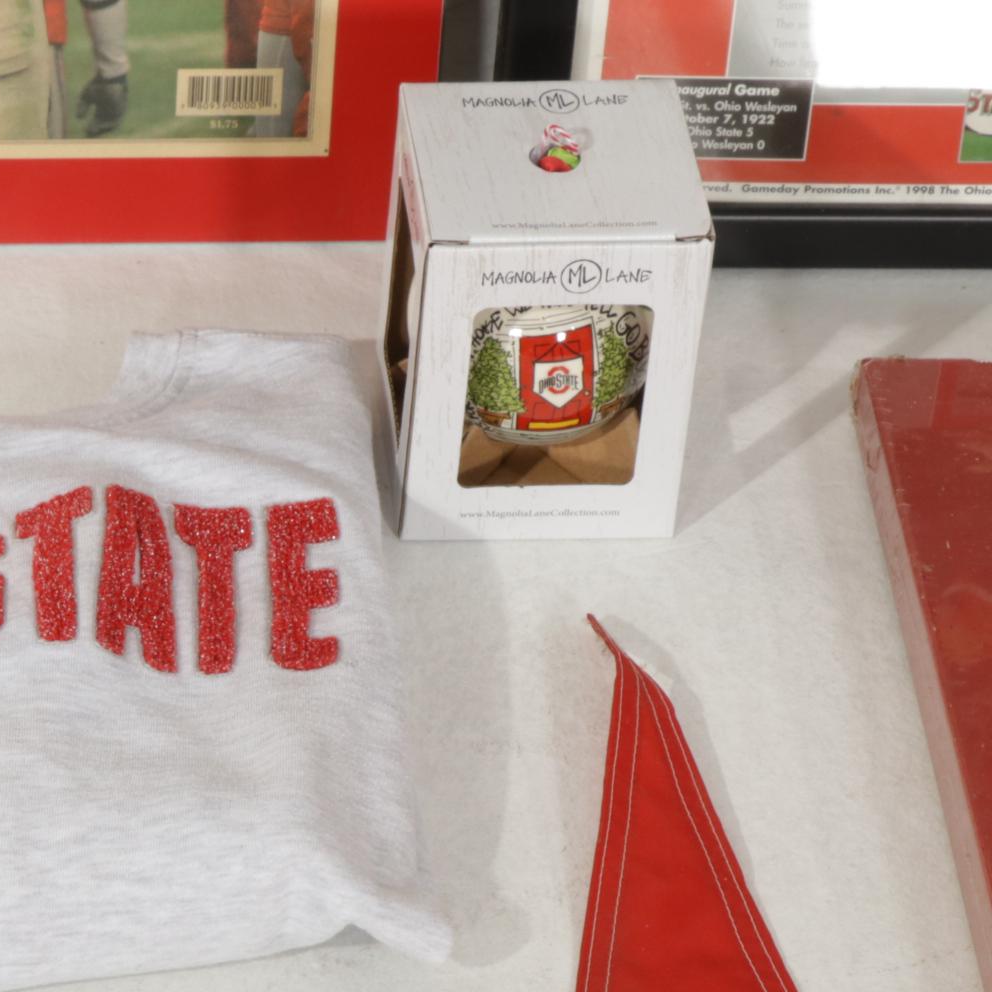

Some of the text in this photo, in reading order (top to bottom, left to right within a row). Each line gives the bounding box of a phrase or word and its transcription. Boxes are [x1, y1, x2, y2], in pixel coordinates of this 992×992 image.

[677, 82, 781, 99] naugural Game
[462, 92, 629, 109] MAGNOLIA ML LANE
[695, 102, 711, 112] vs.
[713, 100, 742, 112] Ohio
[744, 100, 798, 115] Wesleyan
[209, 119, 240, 129] $1.75
[741, 113, 776, 125] 1922
[688, 126, 754, 138] Ohio State 5
[701, 139, 754, 153] Wesleyan
[741, 184, 801, 196] Gameday
[803, 184, 871, 195] Promotions
[906, 185, 937, 195] 1998
[939, 186, 961, 195] The
[963, 186, 992, 196] Ohio
[481, 263, 653, 288] MAGNOLIA ML LANE
